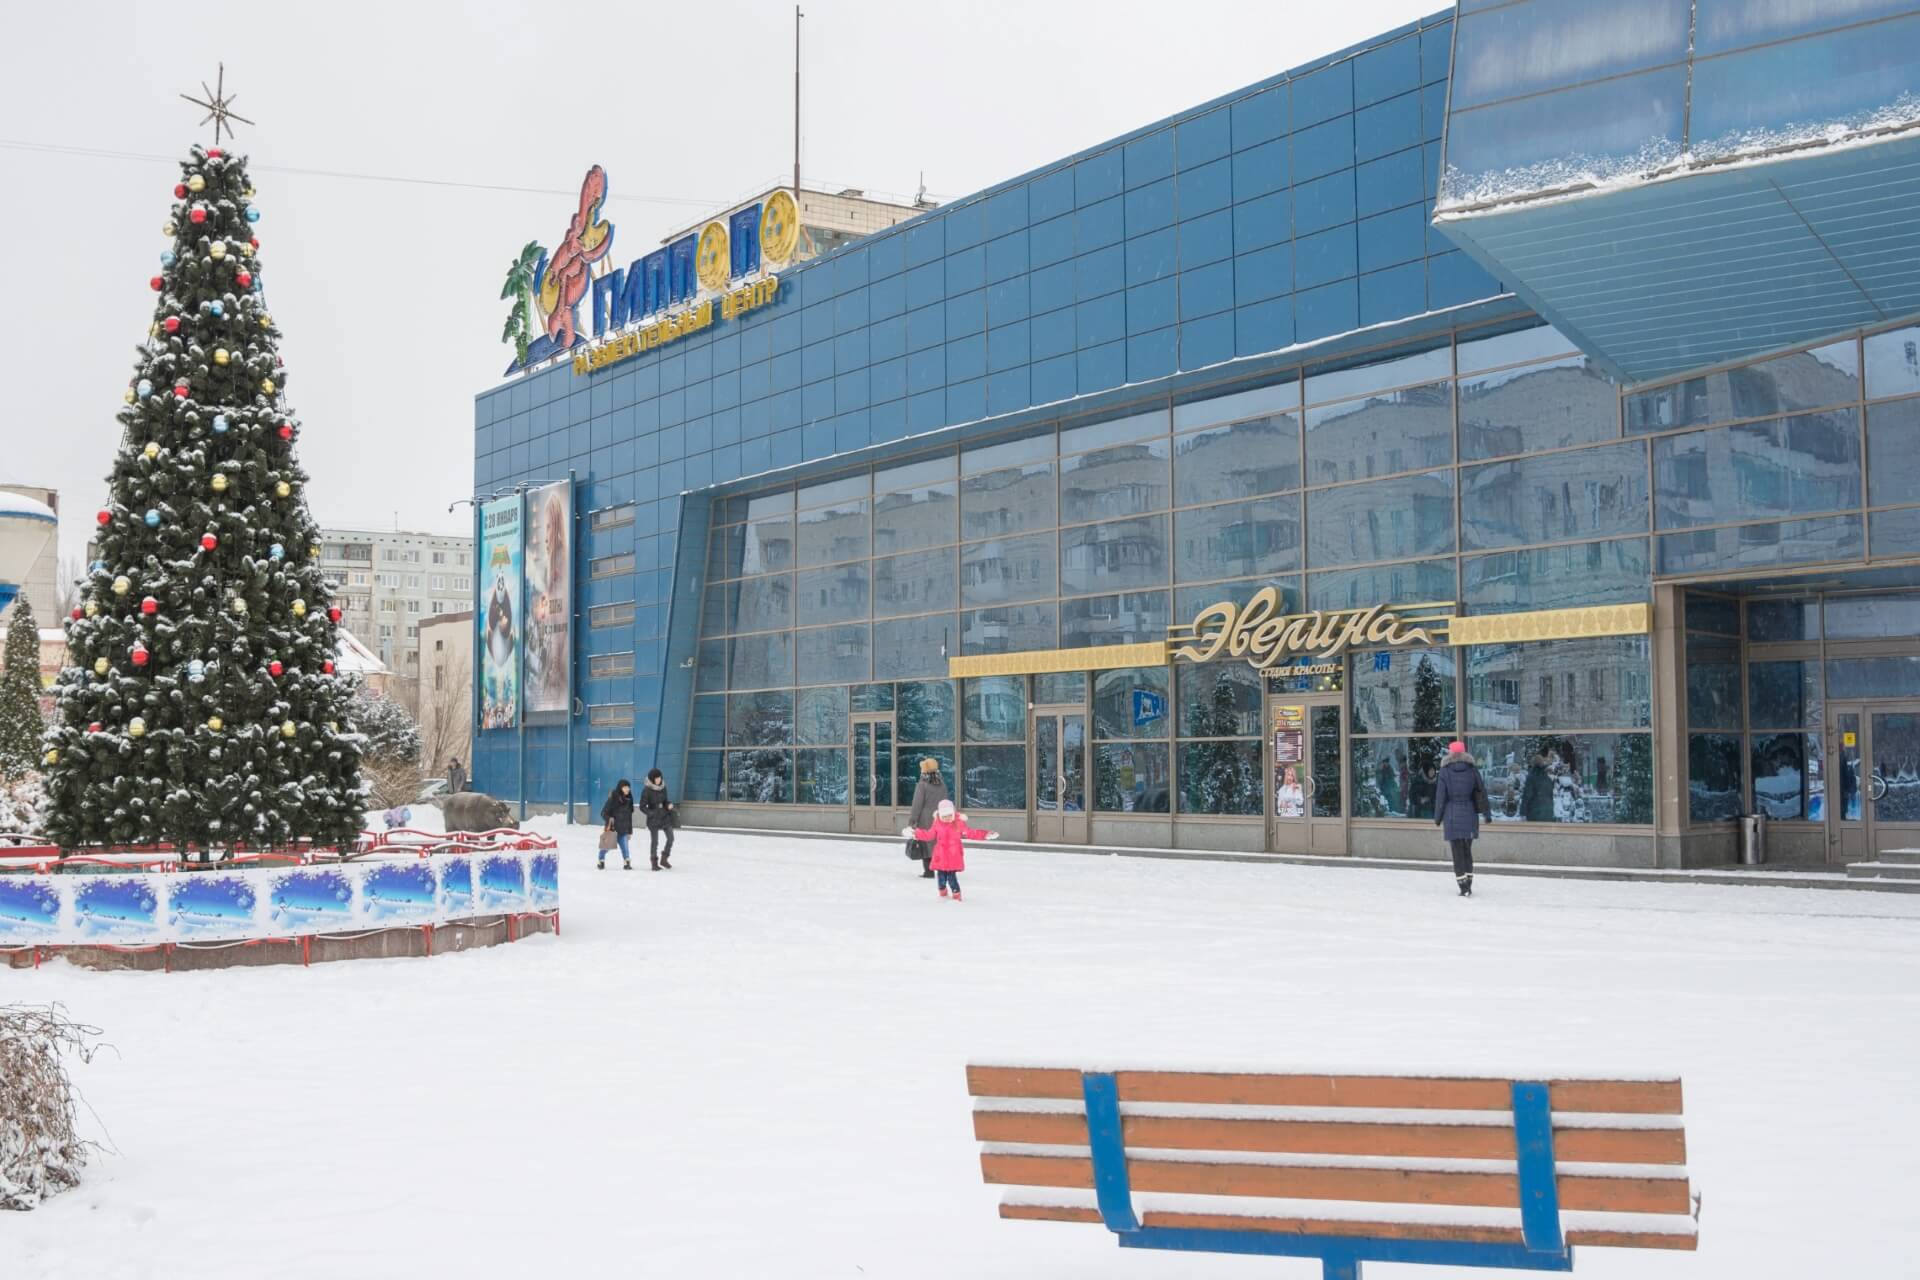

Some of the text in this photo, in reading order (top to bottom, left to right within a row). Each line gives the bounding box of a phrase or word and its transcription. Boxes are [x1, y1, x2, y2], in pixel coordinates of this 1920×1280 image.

[722, 275, 778, 320] ЦЕНТР
[1175, 586, 1432, 668] Эвелина
[1259, 664, 1336, 678] СТУДИЯ КРАСОТЫ
